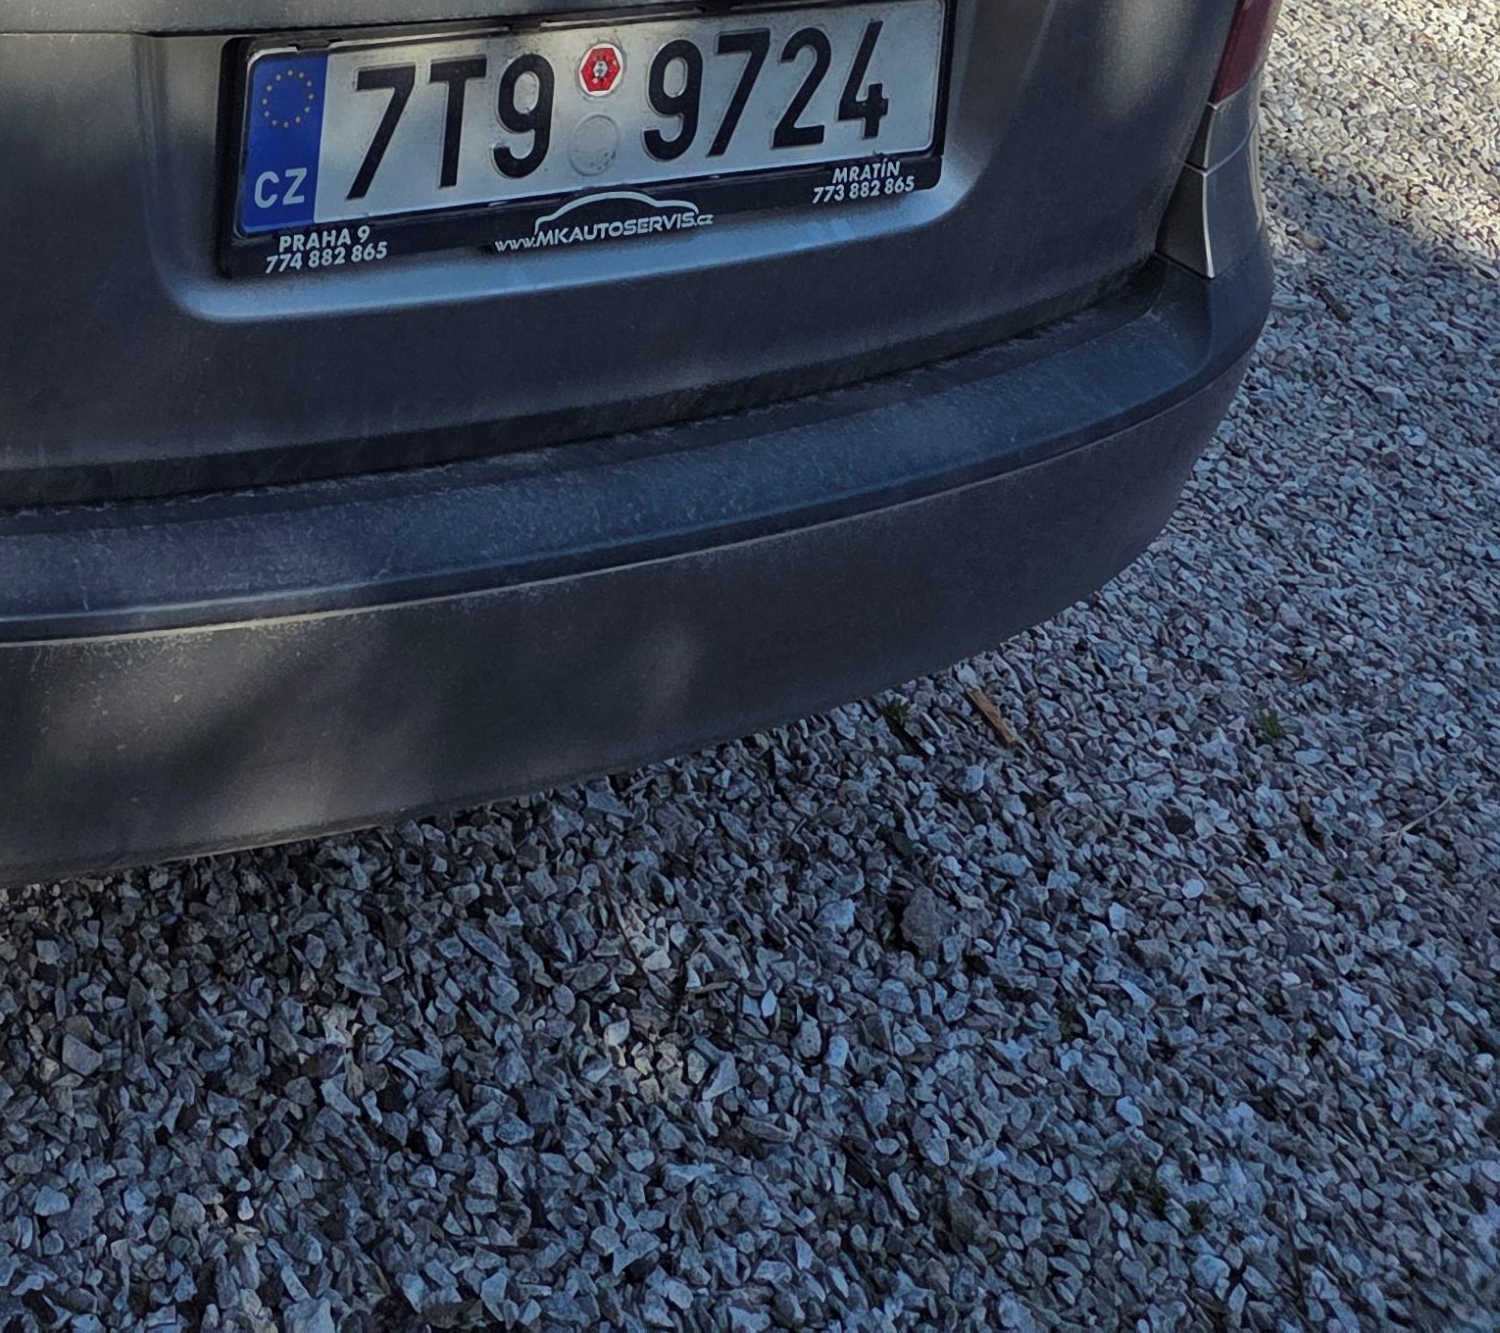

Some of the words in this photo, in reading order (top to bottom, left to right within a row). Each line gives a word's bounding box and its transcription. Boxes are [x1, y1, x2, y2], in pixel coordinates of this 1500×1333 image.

[345, 53, 555, 201] 7T9
[643, 19, 890, 162] 9724
[832, 158, 900, 184] MRATÍN
[254, 167, 308, 209] CZ
[812, 184, 845, 204] 773
[848, 179, 880, 199] 882
[884, 175, 915, 194] 865
[278, 228, 351, 254] PRAHA
[357, 225, 371, 243] 9
[265, 252, 303, 274] 774
[308, 246, 346, 268] 882
[350, 241, 388, 262] 865
